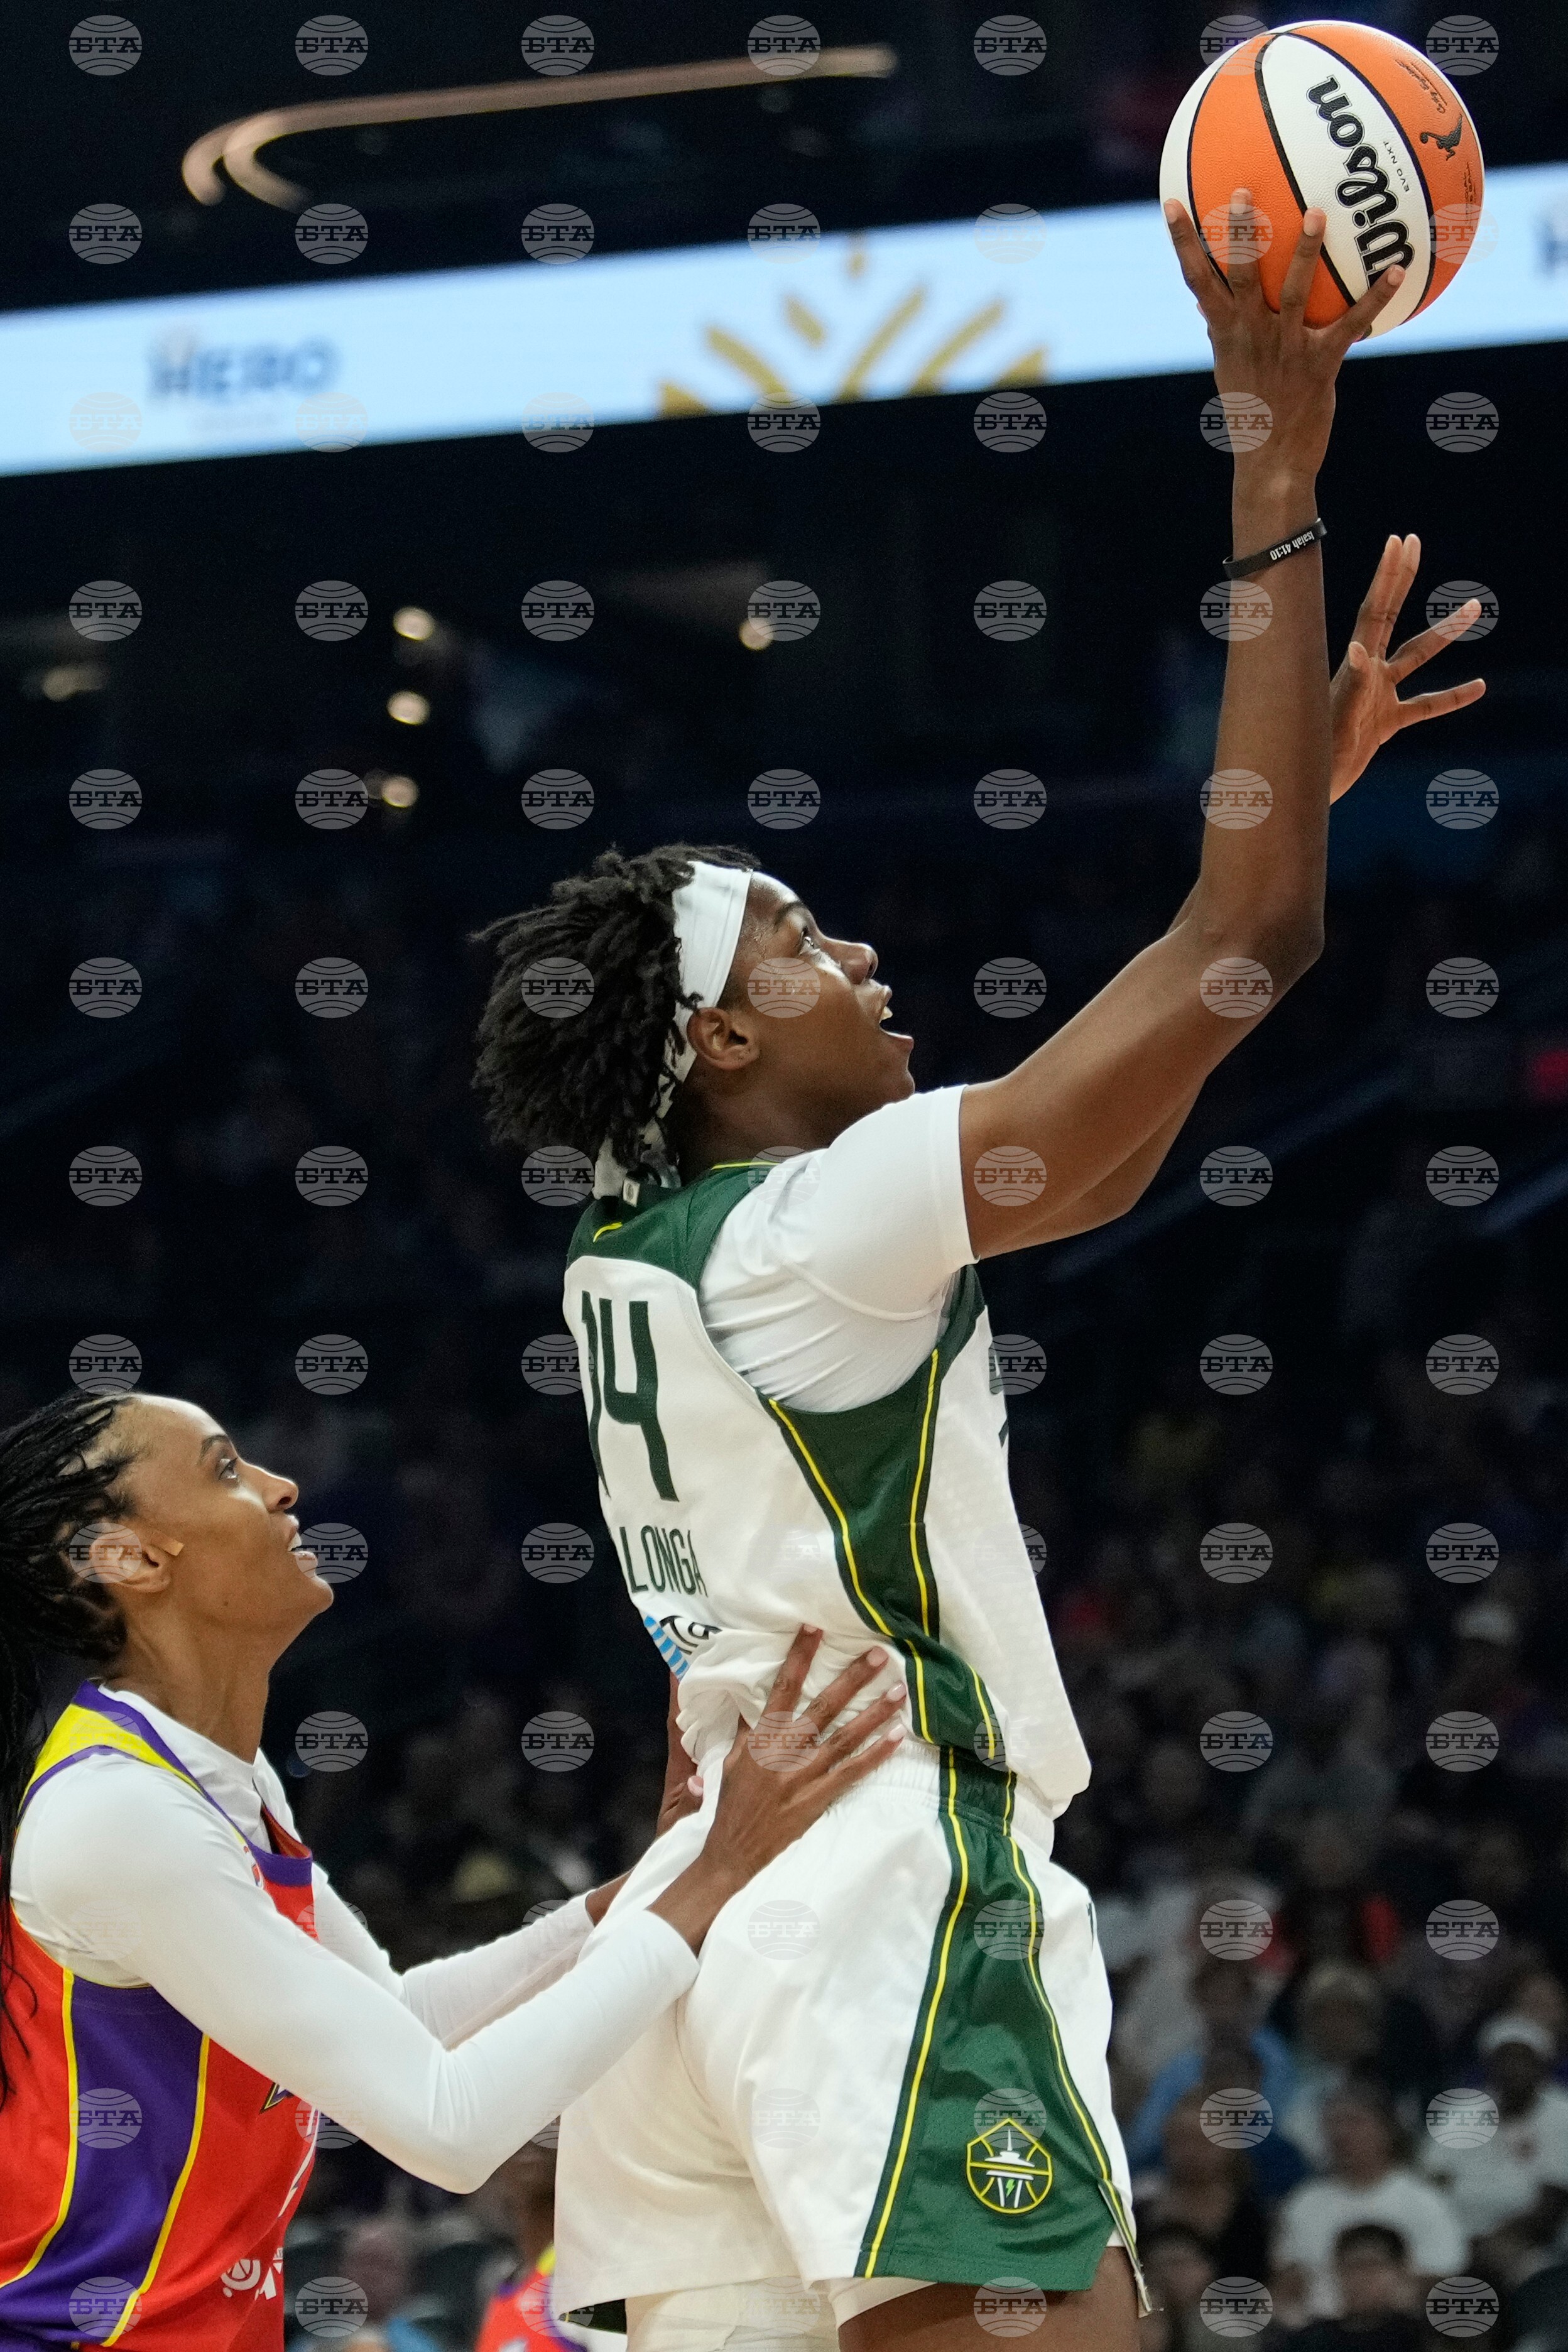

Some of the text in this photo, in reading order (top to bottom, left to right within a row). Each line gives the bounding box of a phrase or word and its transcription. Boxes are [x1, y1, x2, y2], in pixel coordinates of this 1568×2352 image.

[1306, 75, 1415, 290] Wilson
[1383, 141, 1410, 192] EVO NXT
[1270, 531, 1315, 561] Isaiah 41:10
[581, 1290, 680, 1503] 14
